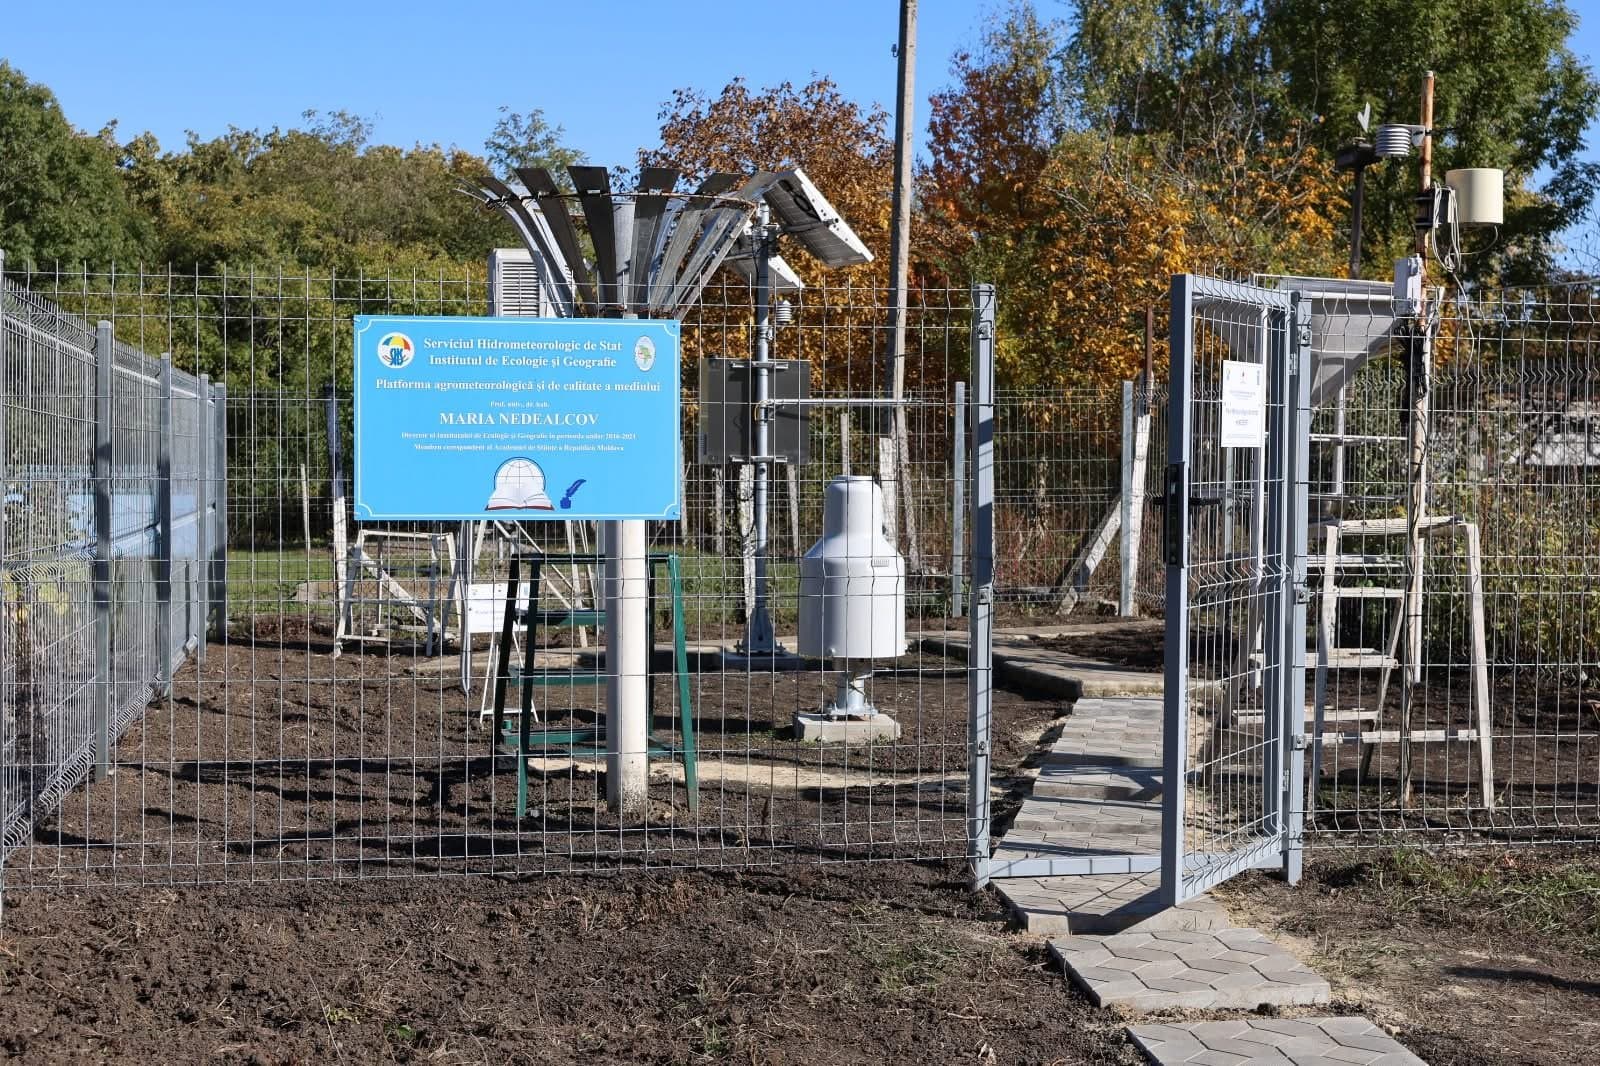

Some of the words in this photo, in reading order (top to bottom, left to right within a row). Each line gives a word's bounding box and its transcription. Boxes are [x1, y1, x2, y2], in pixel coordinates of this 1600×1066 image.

[424, 338, 473, 349] Serviciul
[478, 338, 581, 352] Hidrometeorologic
[584, 340, 597, 350] de
[600, 341, 622, 351] Stat
[430, 355, 482, 365] Institutul
[485, 355, 498, 365] de
[502, 355, 548, 368] Ecologie
[563, 356, 617, 368] Geografie
[376, 379, 431, 389] Platforma
[435, 380, 533, 392] agrometeorologică
[548, 381, 560, 391] de
[563, 381, 602, 391] calitate
[615, 382, 660, 392] mediului
[440, 412, 495, 425] MARIA
[499, 412, 599, 426] NEDEALCOV
[483, 432, 511, 440] Ecologie
[518, 433, 548, 441] Geografie
